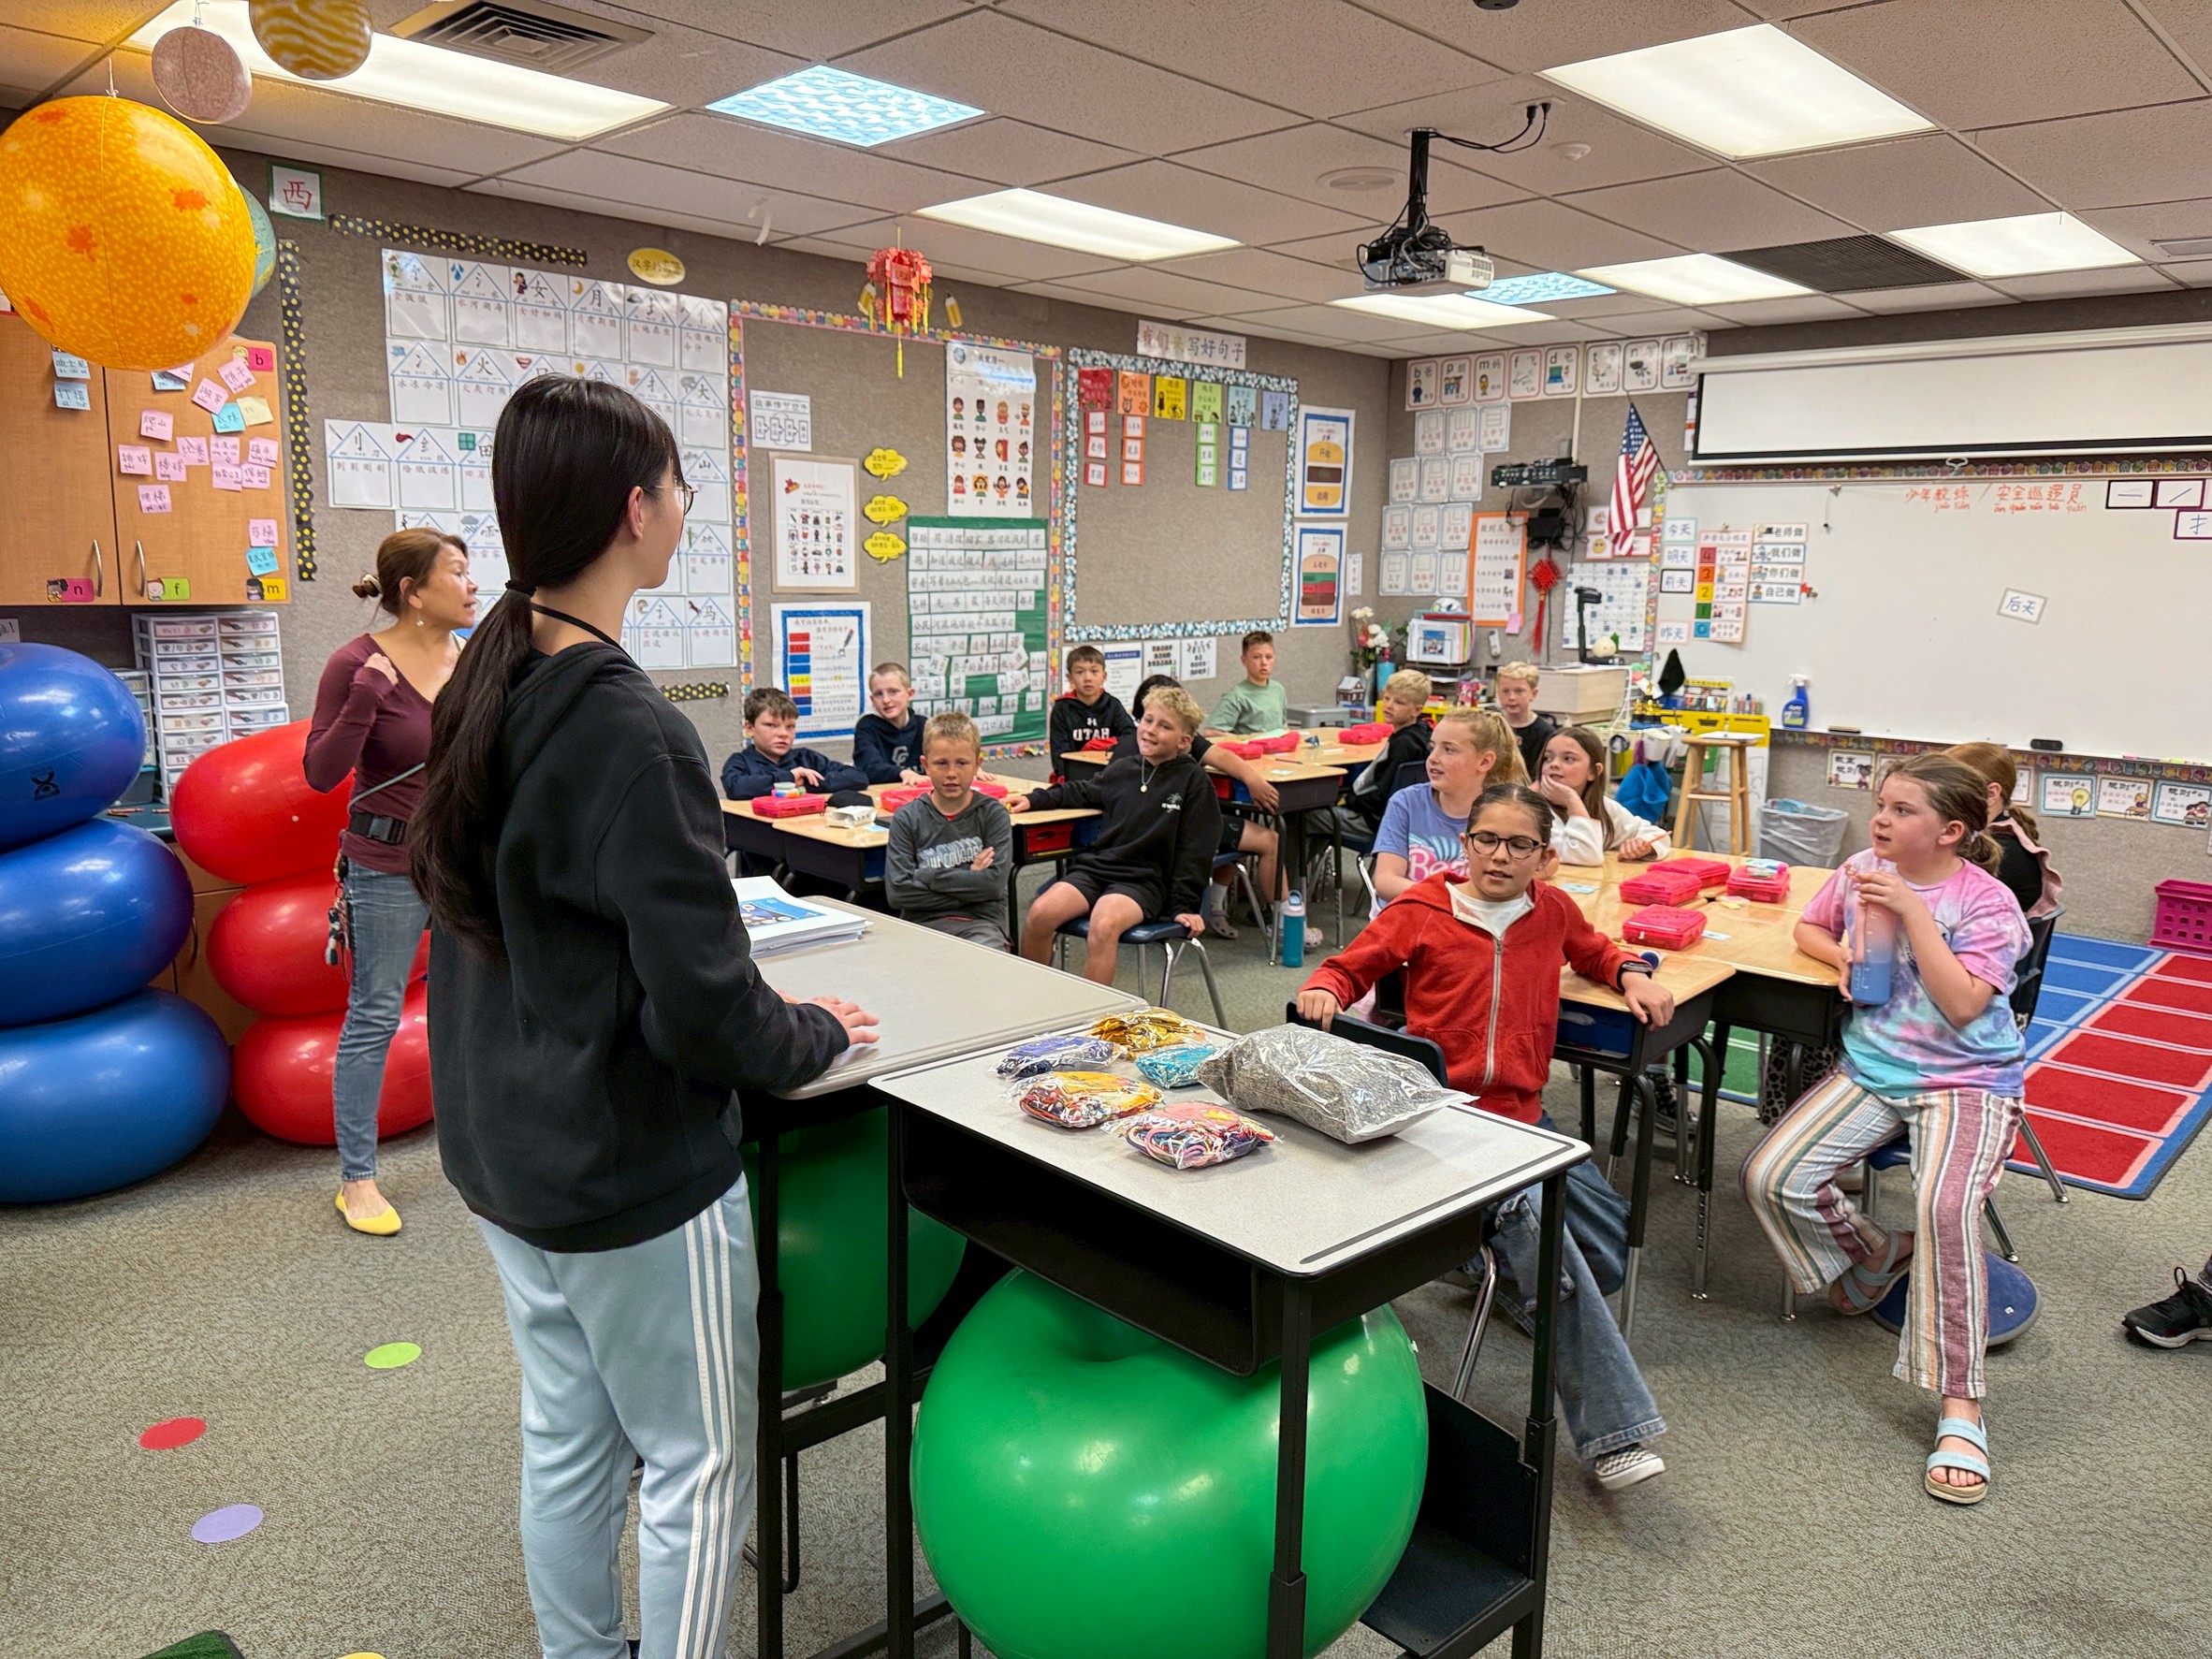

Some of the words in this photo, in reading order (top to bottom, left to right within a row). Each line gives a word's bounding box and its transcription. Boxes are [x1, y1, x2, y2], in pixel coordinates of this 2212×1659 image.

[283, 181, 313, 210] 西
[531, 281, 548, 298] 女
[589, 289, 602, 307] 月
[255, 354, 264, 365] b
[1550, 352, 1557, 364] d
[476, 357, 493, 375] 火
[1447, 363, 1453, 374] p
[1479, 360, 1490, 370] m
[1414, 368, 1420, 378] b
[698, 384, 710, 400] 大
[1668, 523, 1691, 536] 今天
[1666, 548, 1689, 562] 明天
[1704, 551, 1710, 560] 4
[1703, 568, 1710, 579] 3
[73, 585, 83, 595] n
[174, 583, 180, 595] f
[267, 585, 280, 594] m
[1701, 587, 1709, 598] 2
[1766, 588, 1796, 598] 自己做
[704, 605, 717, 621] 马
[1072, 727, 1110, 741] UTAH
